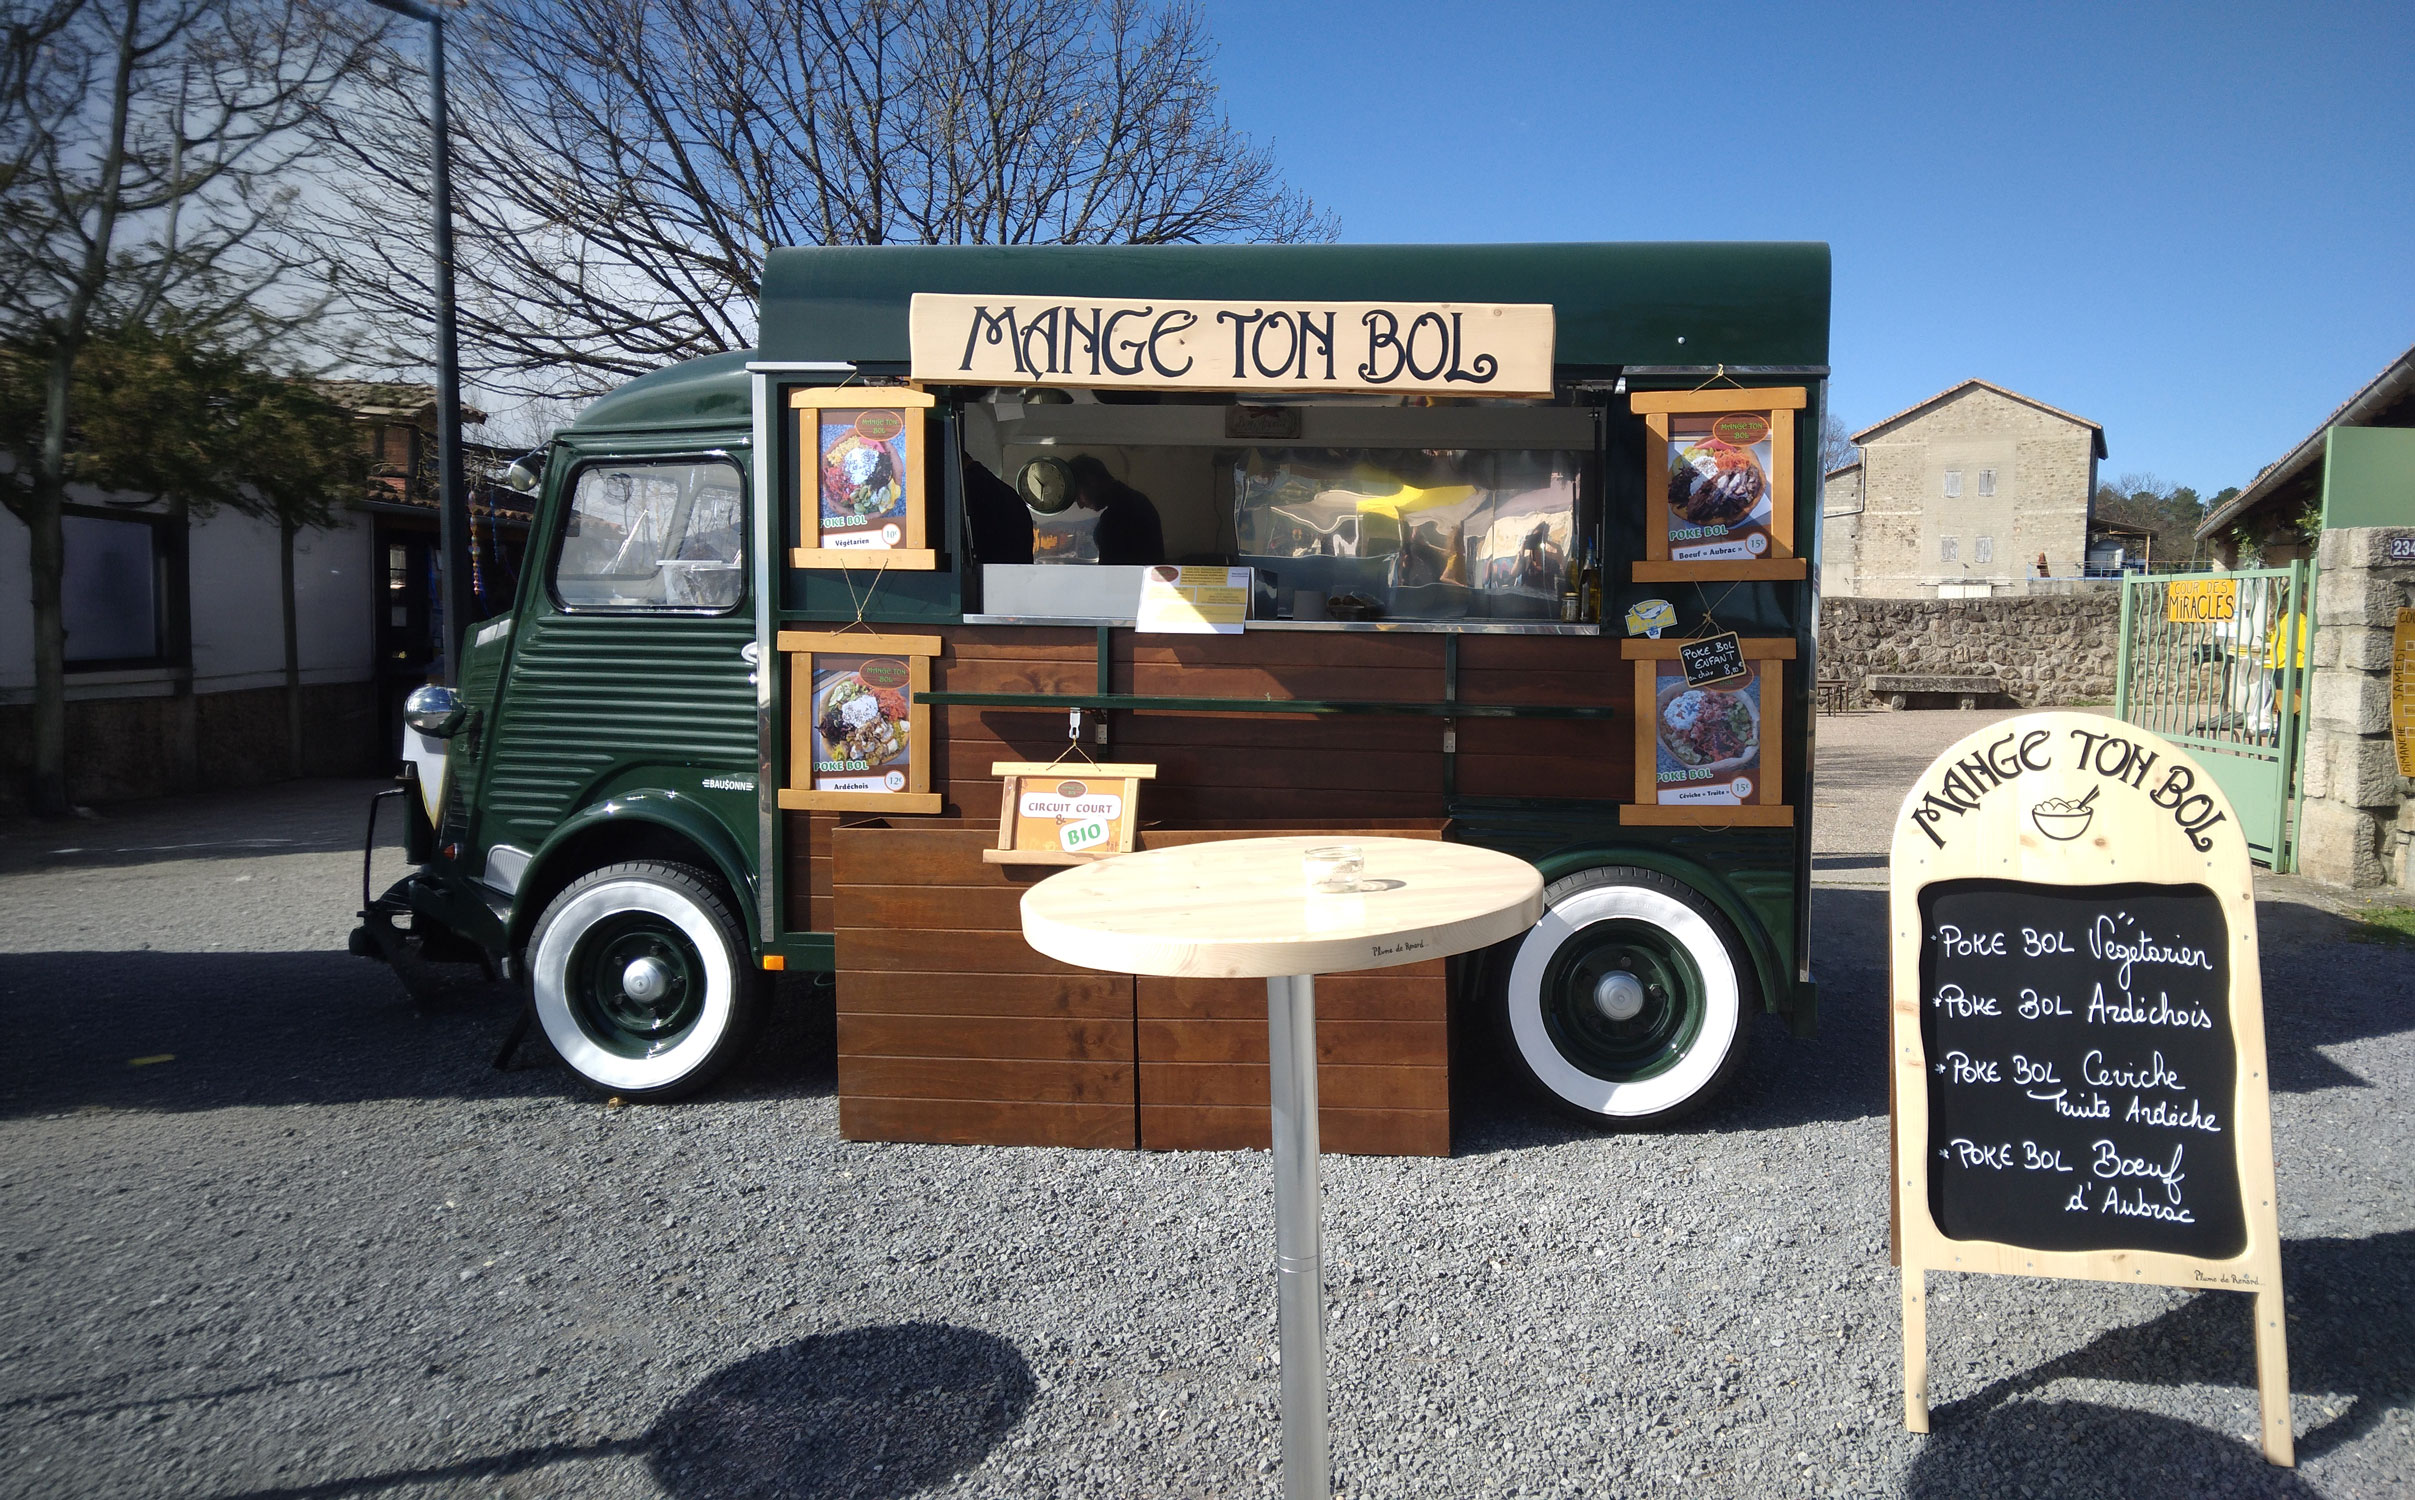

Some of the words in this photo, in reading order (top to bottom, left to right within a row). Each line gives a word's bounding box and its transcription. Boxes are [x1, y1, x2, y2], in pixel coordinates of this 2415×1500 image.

[958, 304, 1198, 381] MANGE
[1217, 307, 1338, 380] TON
[1358, 308, 1498, 385] BOL
[819, 517, 846, 529] POKE
[847, 514, 868, 527] BOL
[835, 538, 870, 547] Végétarien
[1669, 527, 1702, 542] POKE
[1704, 524, 1729, 537] BOL
[2174, 582, 2199, 595] COUR
[2206, 581, 2228, 594] DES
[1682, 646, 1711, 660] POKE
[1715, 641, 1735, 653] BOL
[1694, 650, 1735, 669] ENFANT
[814, 761, 845, 772] POKE
[847, 760, 870, 771] BOL
[1656, 770, 1687, 783] POKE
[1689, 768, 1714, 779] BOL
[834, 782, 869, 790] Ardéchois
[1911, 729, 2051, 850] MANGE
[2071, 729, 2160, 790] TON
[2150, 765, 2227, 852] BOL
[1028, 802, 1071, 813] CIRCUIT
[1076, 804, 1113, 814] COURT
[1067, 823, 1101, 846] BIO
[1939, 925, 2007, 958] POKE
[2021, 928, 2075, 957] BOL
[1939, 983, 2002, 1018] POKE
[2018, 988, 2073, 1020] BOL
[1946, 1050, 2002, 1083] POKE
[2012, 1054, 2061, 1085] BOL
[2026, 1088, 2111, 1118] Truite
[1950, 1138, 2014, 1169] POKE
[2022, 1141, 2073, 1172] BOL
[2194, 1269, 2217, 1283] Plume
[2220, 1273, 2230, 1283] de
